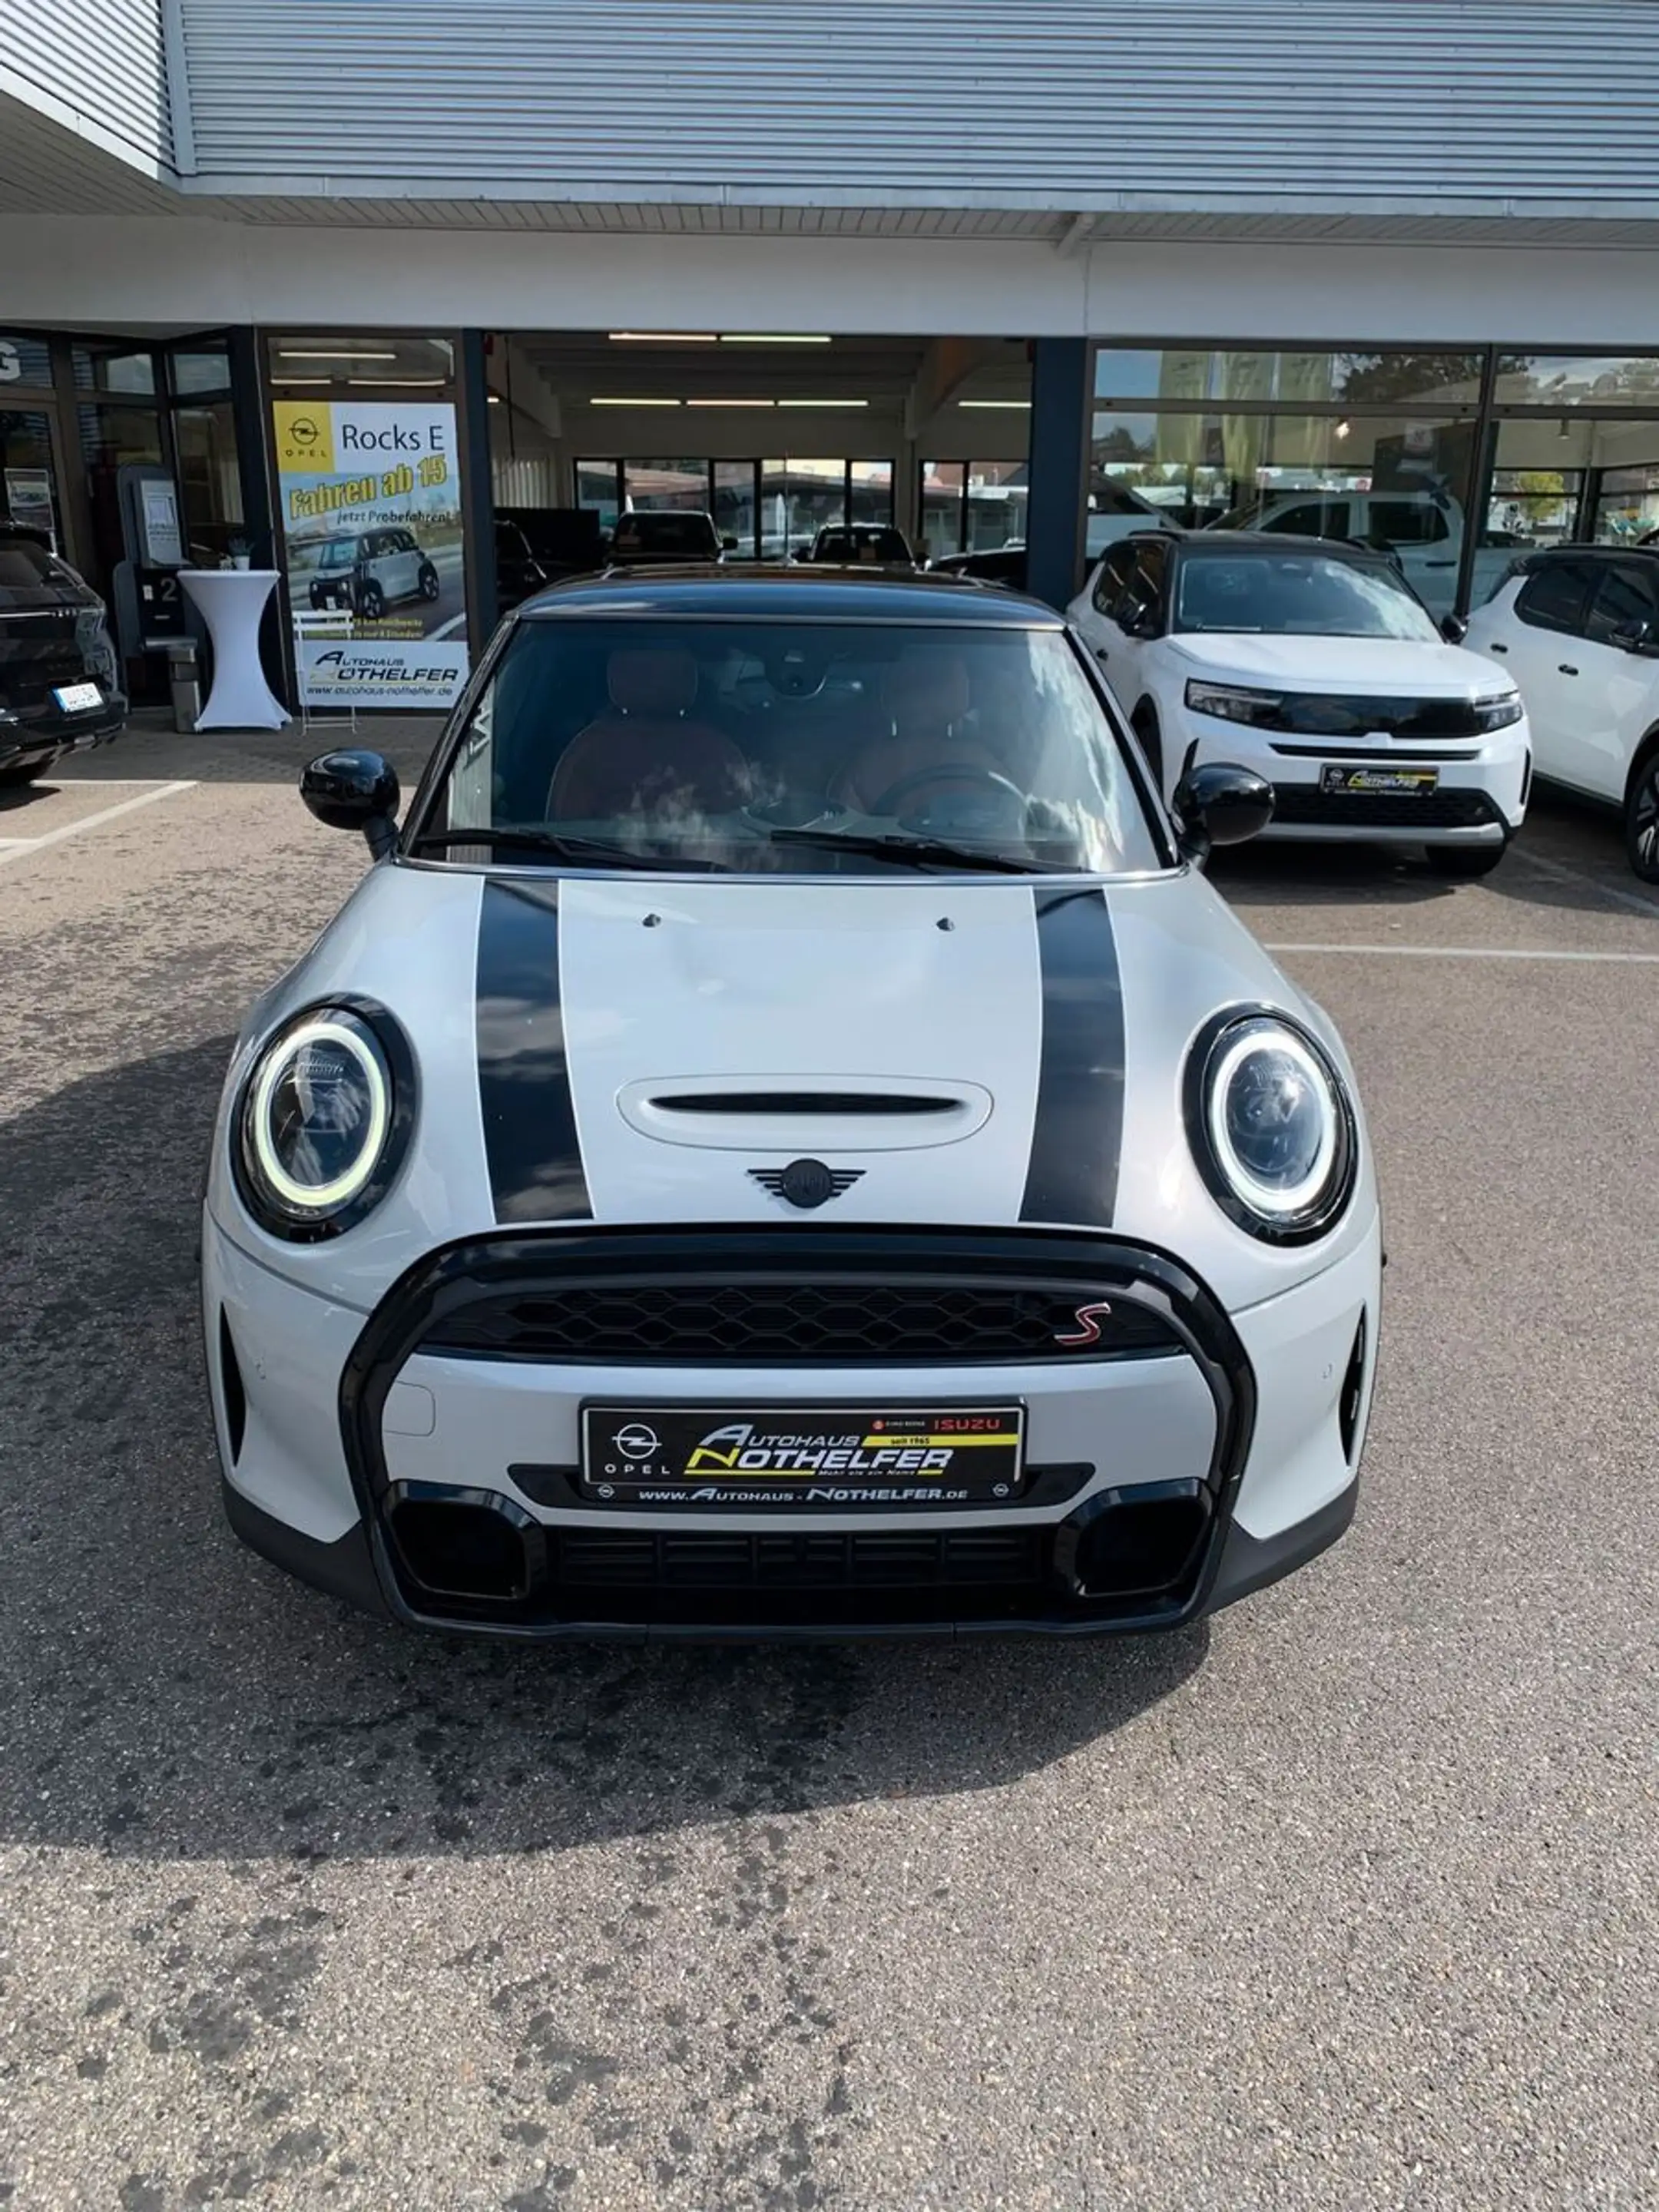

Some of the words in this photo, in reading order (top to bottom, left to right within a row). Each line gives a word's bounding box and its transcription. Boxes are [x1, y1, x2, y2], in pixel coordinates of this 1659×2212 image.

[342, 423, 421, 451] Rocks
[429, 426, 445, 451] E
[285, 449, 327, 458] OPEL
[290, 475, 376, 520] Fahren
[381, 462, 414, 498] ab
[416, 454, 448, 488] 15
[160, 578, 178, 601] 2
[1054, 1301, 1112, 1346] S
[698, 1424, 860, 1447] AUTOHAUS
[934, 1418, 1000, 1430] ISUZU
[604, 1462, 671, 1475] OPEL
[686, 1446, 954, 1469] NOTHELFER
